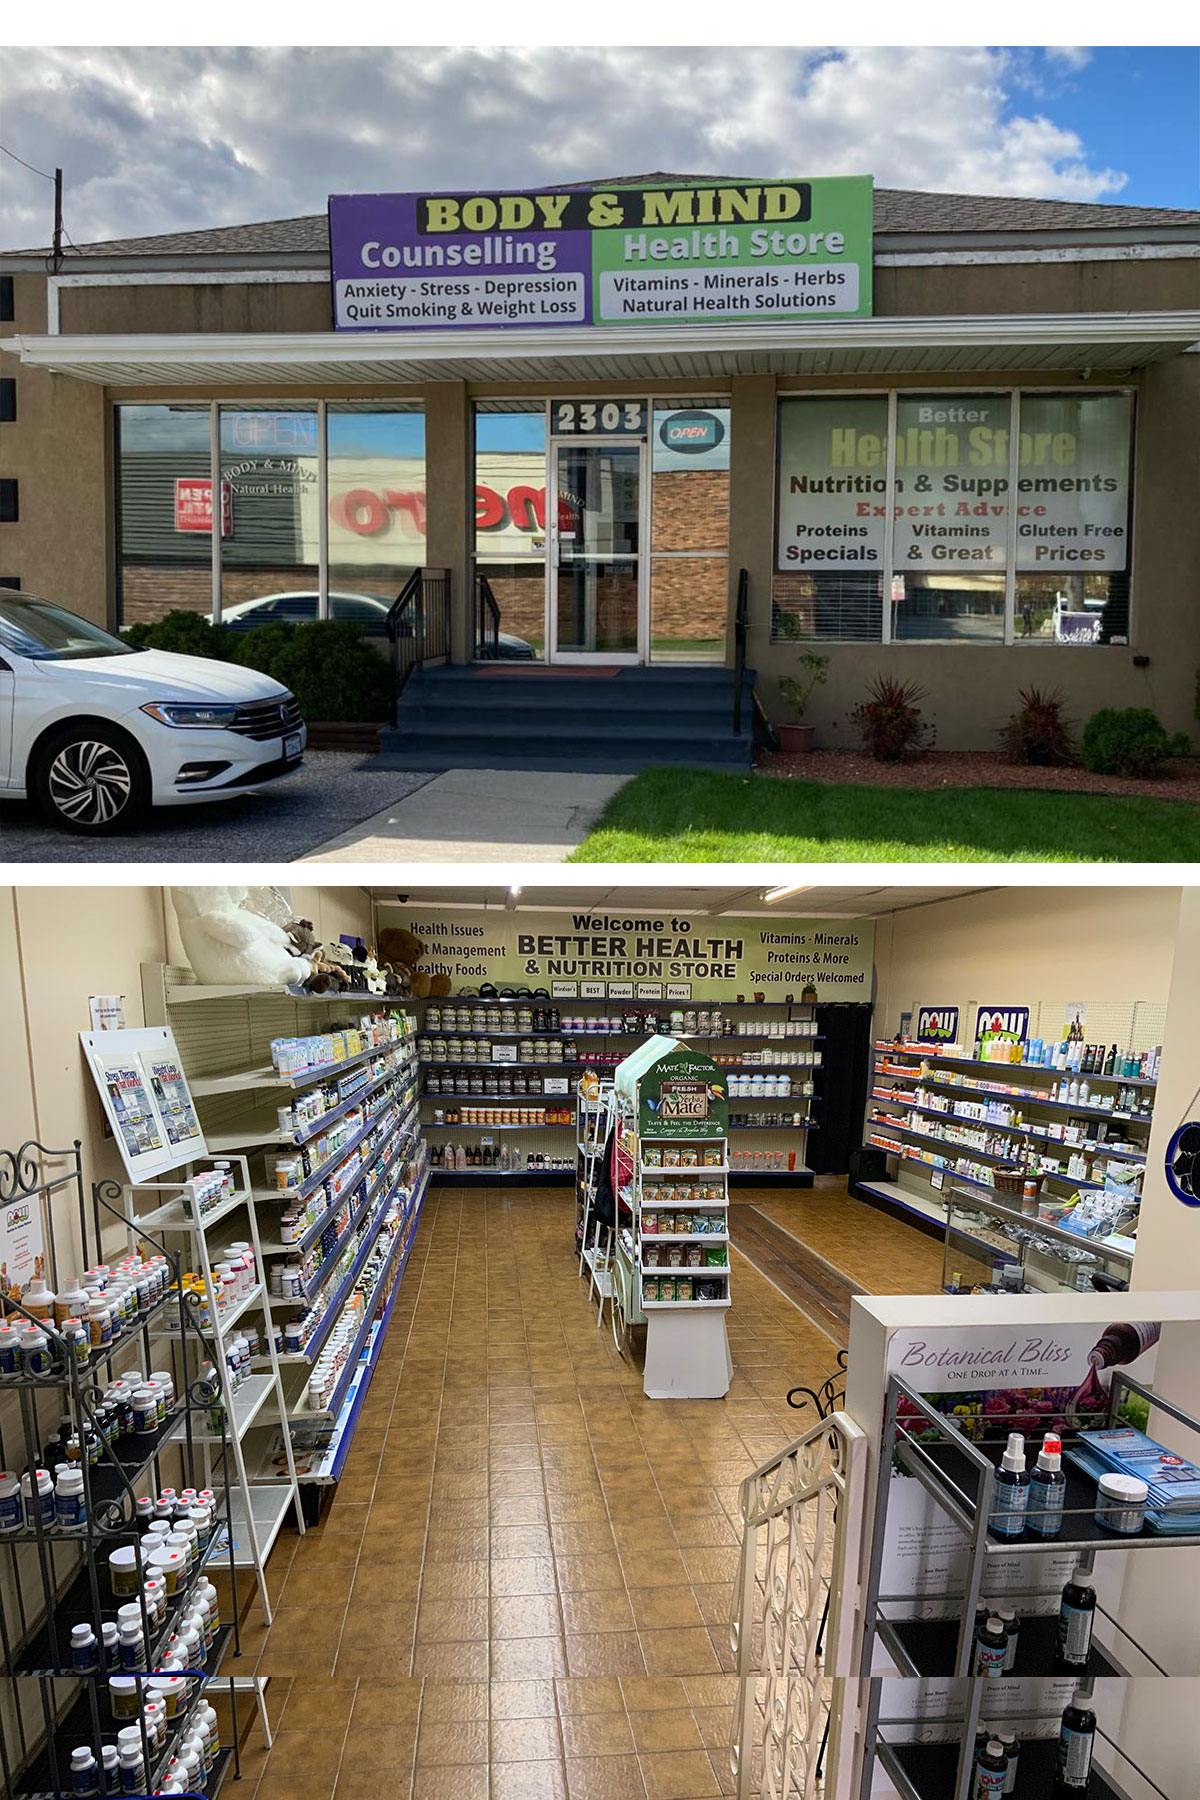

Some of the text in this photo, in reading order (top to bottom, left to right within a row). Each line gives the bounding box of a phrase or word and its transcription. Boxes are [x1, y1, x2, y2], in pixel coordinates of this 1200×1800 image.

[426, 186, 802, 232] BODY & MIND
[360, 236, 557, 271] Counselling
[623, 227, 846, 263] Health Store
[345, 282, 406, 301] Anxiety
[420, 281, 470, 297] Stress
[485, 279, 577, 298] Depression
[613, 275, 689, 292] Vitamins
[703, 273, 780, 289] Minerals
[794, 270, 846, 286] Herbs
[346, 298, 577, 322] Quit Smoking & Weight Loss
[622, 291, 837, 313] Natural Health Solutions
[558, 403, 642, 431] 2303
[919, 407, 989, 423] Better
[235, 416, 314, 445] OPEN
[668, 426, 708, 439] OPEN
[969, 426, 1077, 467] Store
[223, 459, 318, 482] BODY & MIND
[231, 483, 309, 494] Natural Health
[914, 475, 933, 493] &
[943, 474, 1118, 497] Suppements
[955, 501, 1047, 517] Advce
[796, 524, 1124, 538] Proteins Vitamins Gluten Free
[786, 545, 1106, 564] Specials & Great Prices
[410, 922, 484, 937] Health Issues
[572, 915, 691, 932] Welcome to
[518, 935, 743, 959] BETTER HEALTH
[760, 932, 806, 945] Vitamins
[814, 933, 859, 946] Minerals
[432, 944, 506, 959] Management
[767, 952, 849, 965] Proteins & More
[455, 964, 487, 976] Foods
[525, 959, 737, 978] & NUTRITION STORE
[750, 971, 865, 984] Special Orders Welcomed
[664, 1100, 703, 1115] Maté
[900, 1337, 1073, 1367] Botanical Bliss
